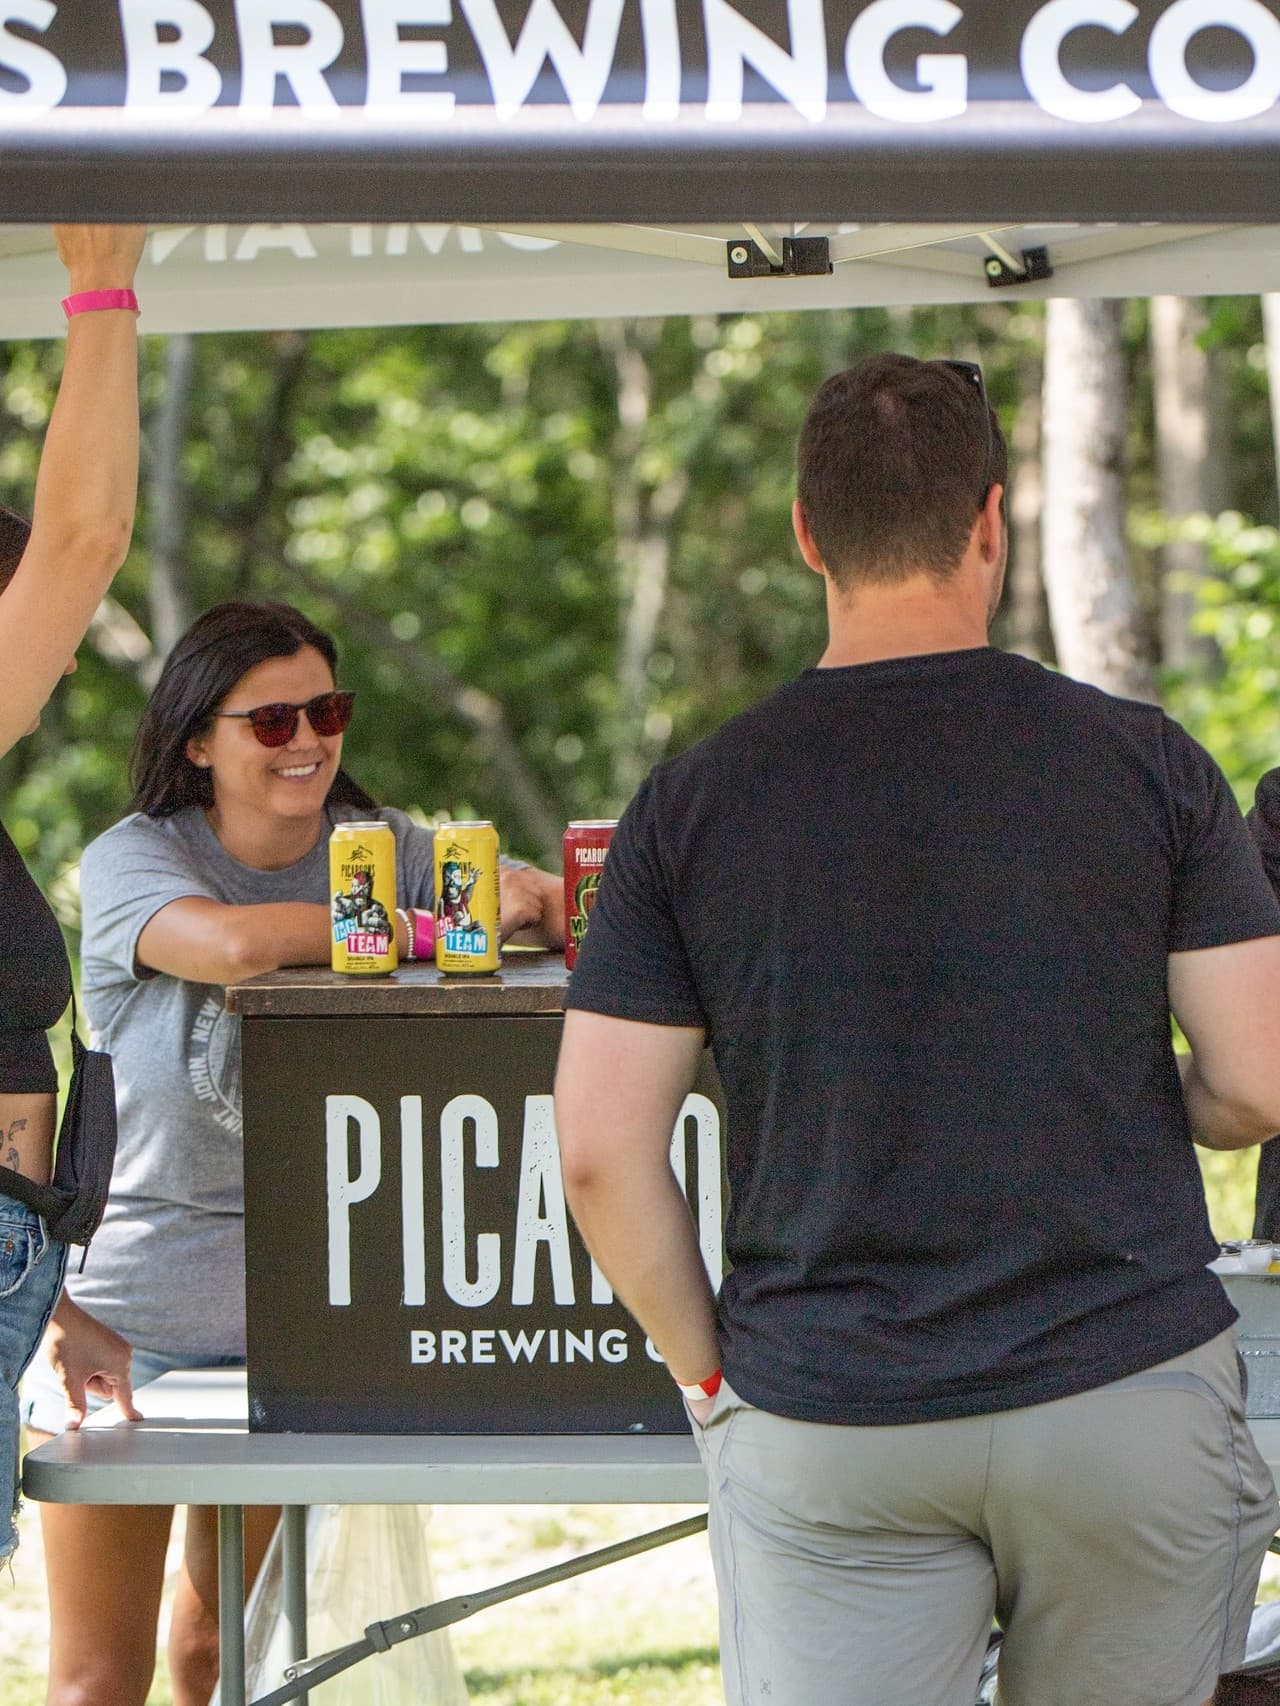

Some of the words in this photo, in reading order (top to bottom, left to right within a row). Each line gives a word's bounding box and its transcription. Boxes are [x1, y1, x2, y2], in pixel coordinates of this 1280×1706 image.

[123, 0, 968, 123] BREWING
[348, 935, 388, 954] TEAM
[447, 932, 486, 951] TEAM
[191, 998, 221, 1043] NEW
[326, 1093, 723, 1308] PICAO
[410, 1328, 629, 1364] BREWING
